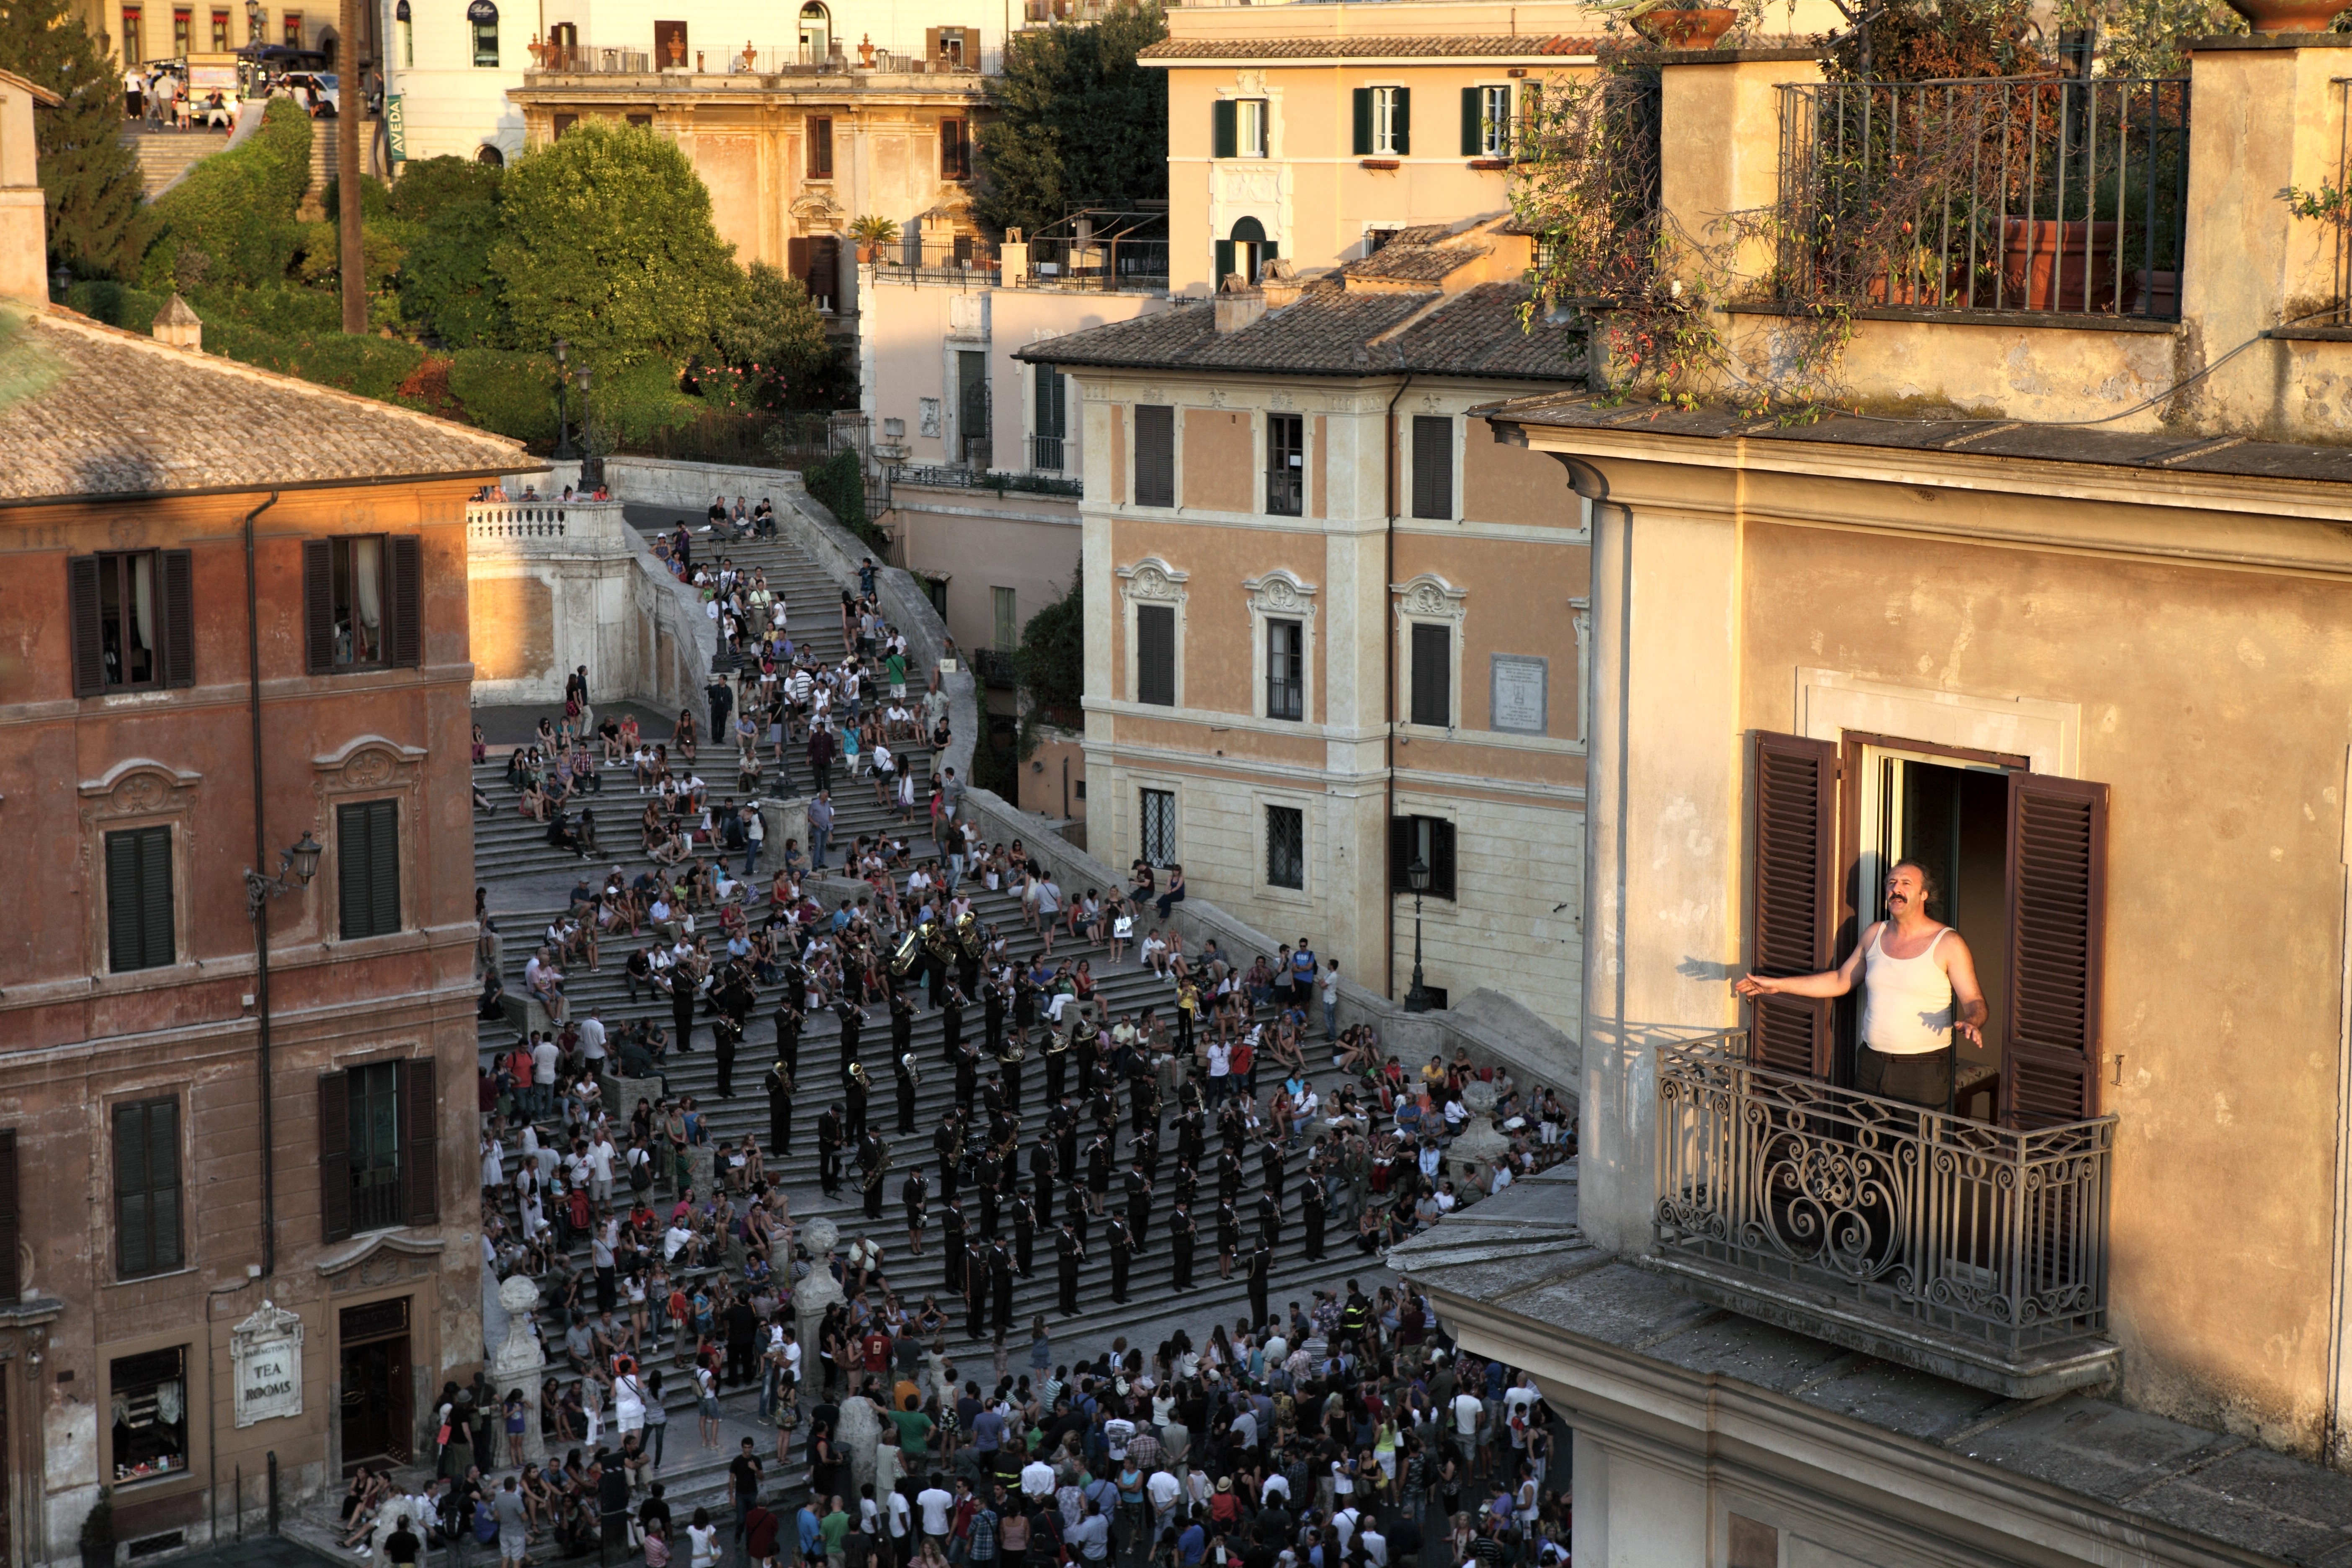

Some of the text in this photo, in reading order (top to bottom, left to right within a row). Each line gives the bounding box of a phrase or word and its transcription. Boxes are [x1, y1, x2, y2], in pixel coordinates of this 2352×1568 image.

[389, 101, 404, 153] AVEDA
[254, 1363, 281, 1378] TEA
[245, 1380, 291, 1401] ROOMS
